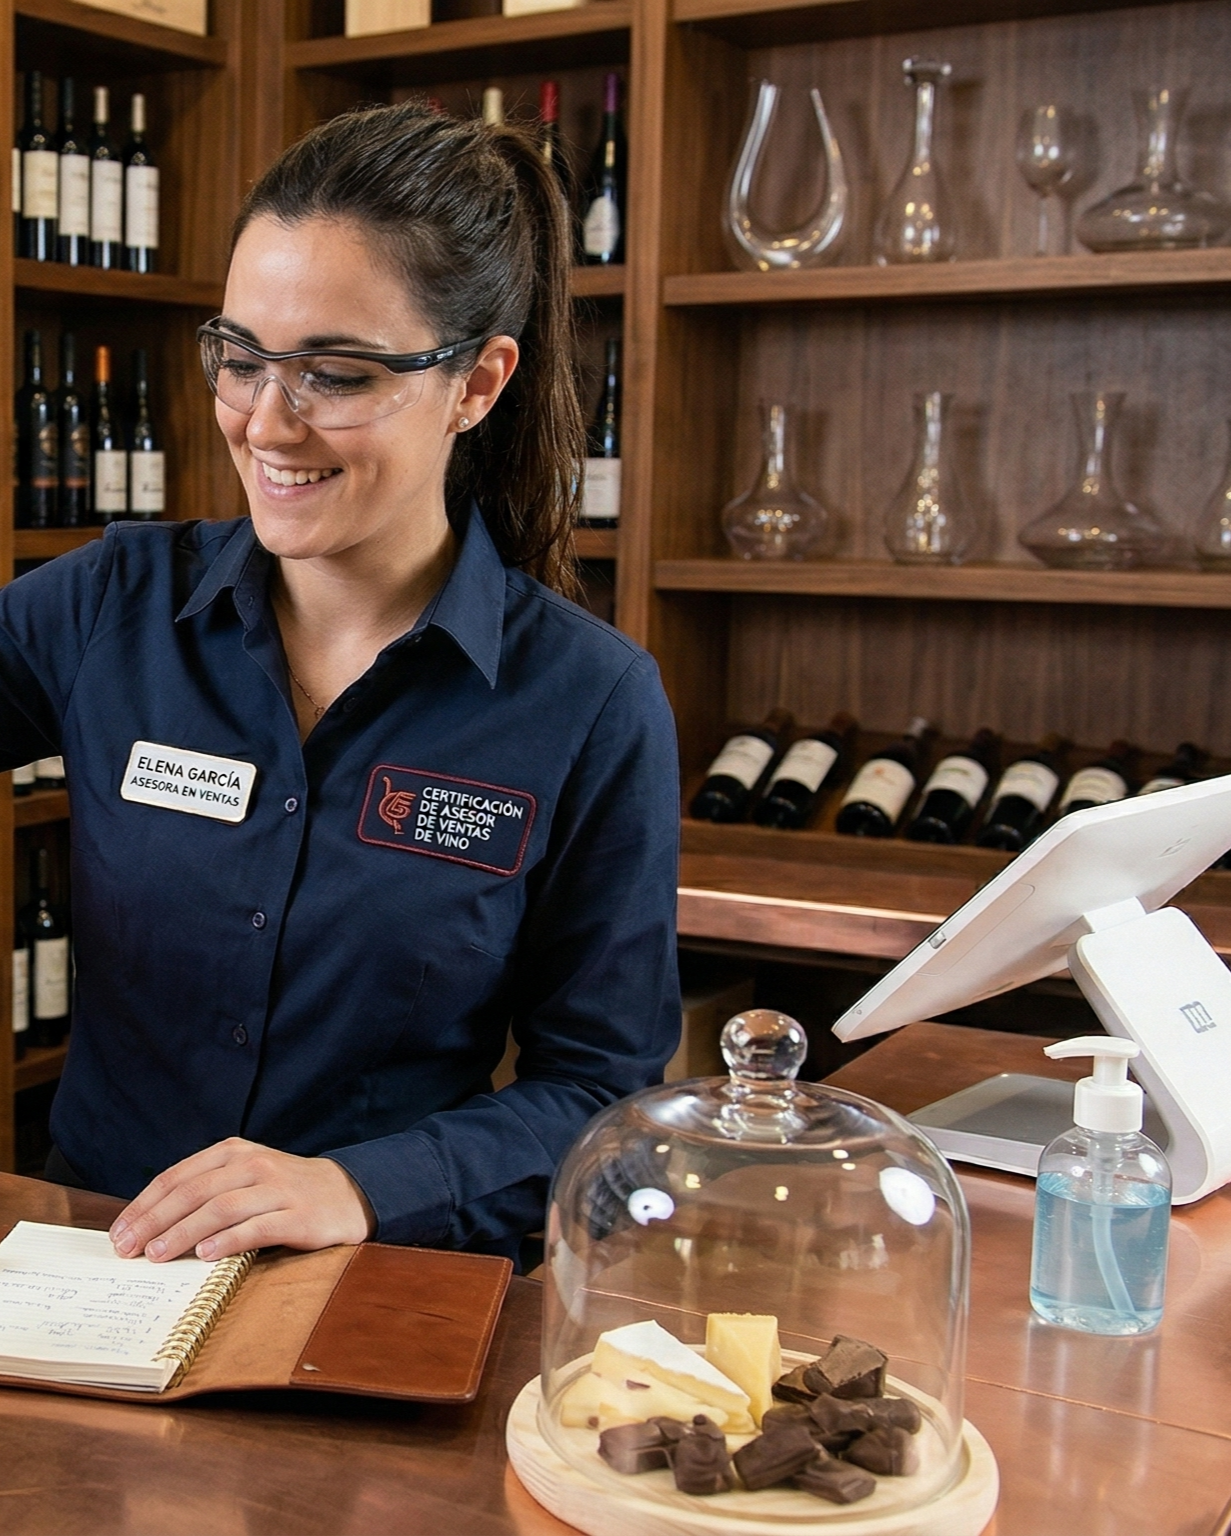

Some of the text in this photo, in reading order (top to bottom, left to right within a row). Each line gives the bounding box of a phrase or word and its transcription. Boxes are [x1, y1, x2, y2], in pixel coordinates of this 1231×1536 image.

[137, 756, 241, 790] ELENA GARCÍA
[130, 775, 240, 807] ASESORA EN VENTAS
[422, 786, 523, 819] CERTIFICACIÓN
[417, 814, 491, 841] DE VENTAS
[419, 800, 496, 828] DE ASESOR
[414, 828, 470, 850] DE VINO
